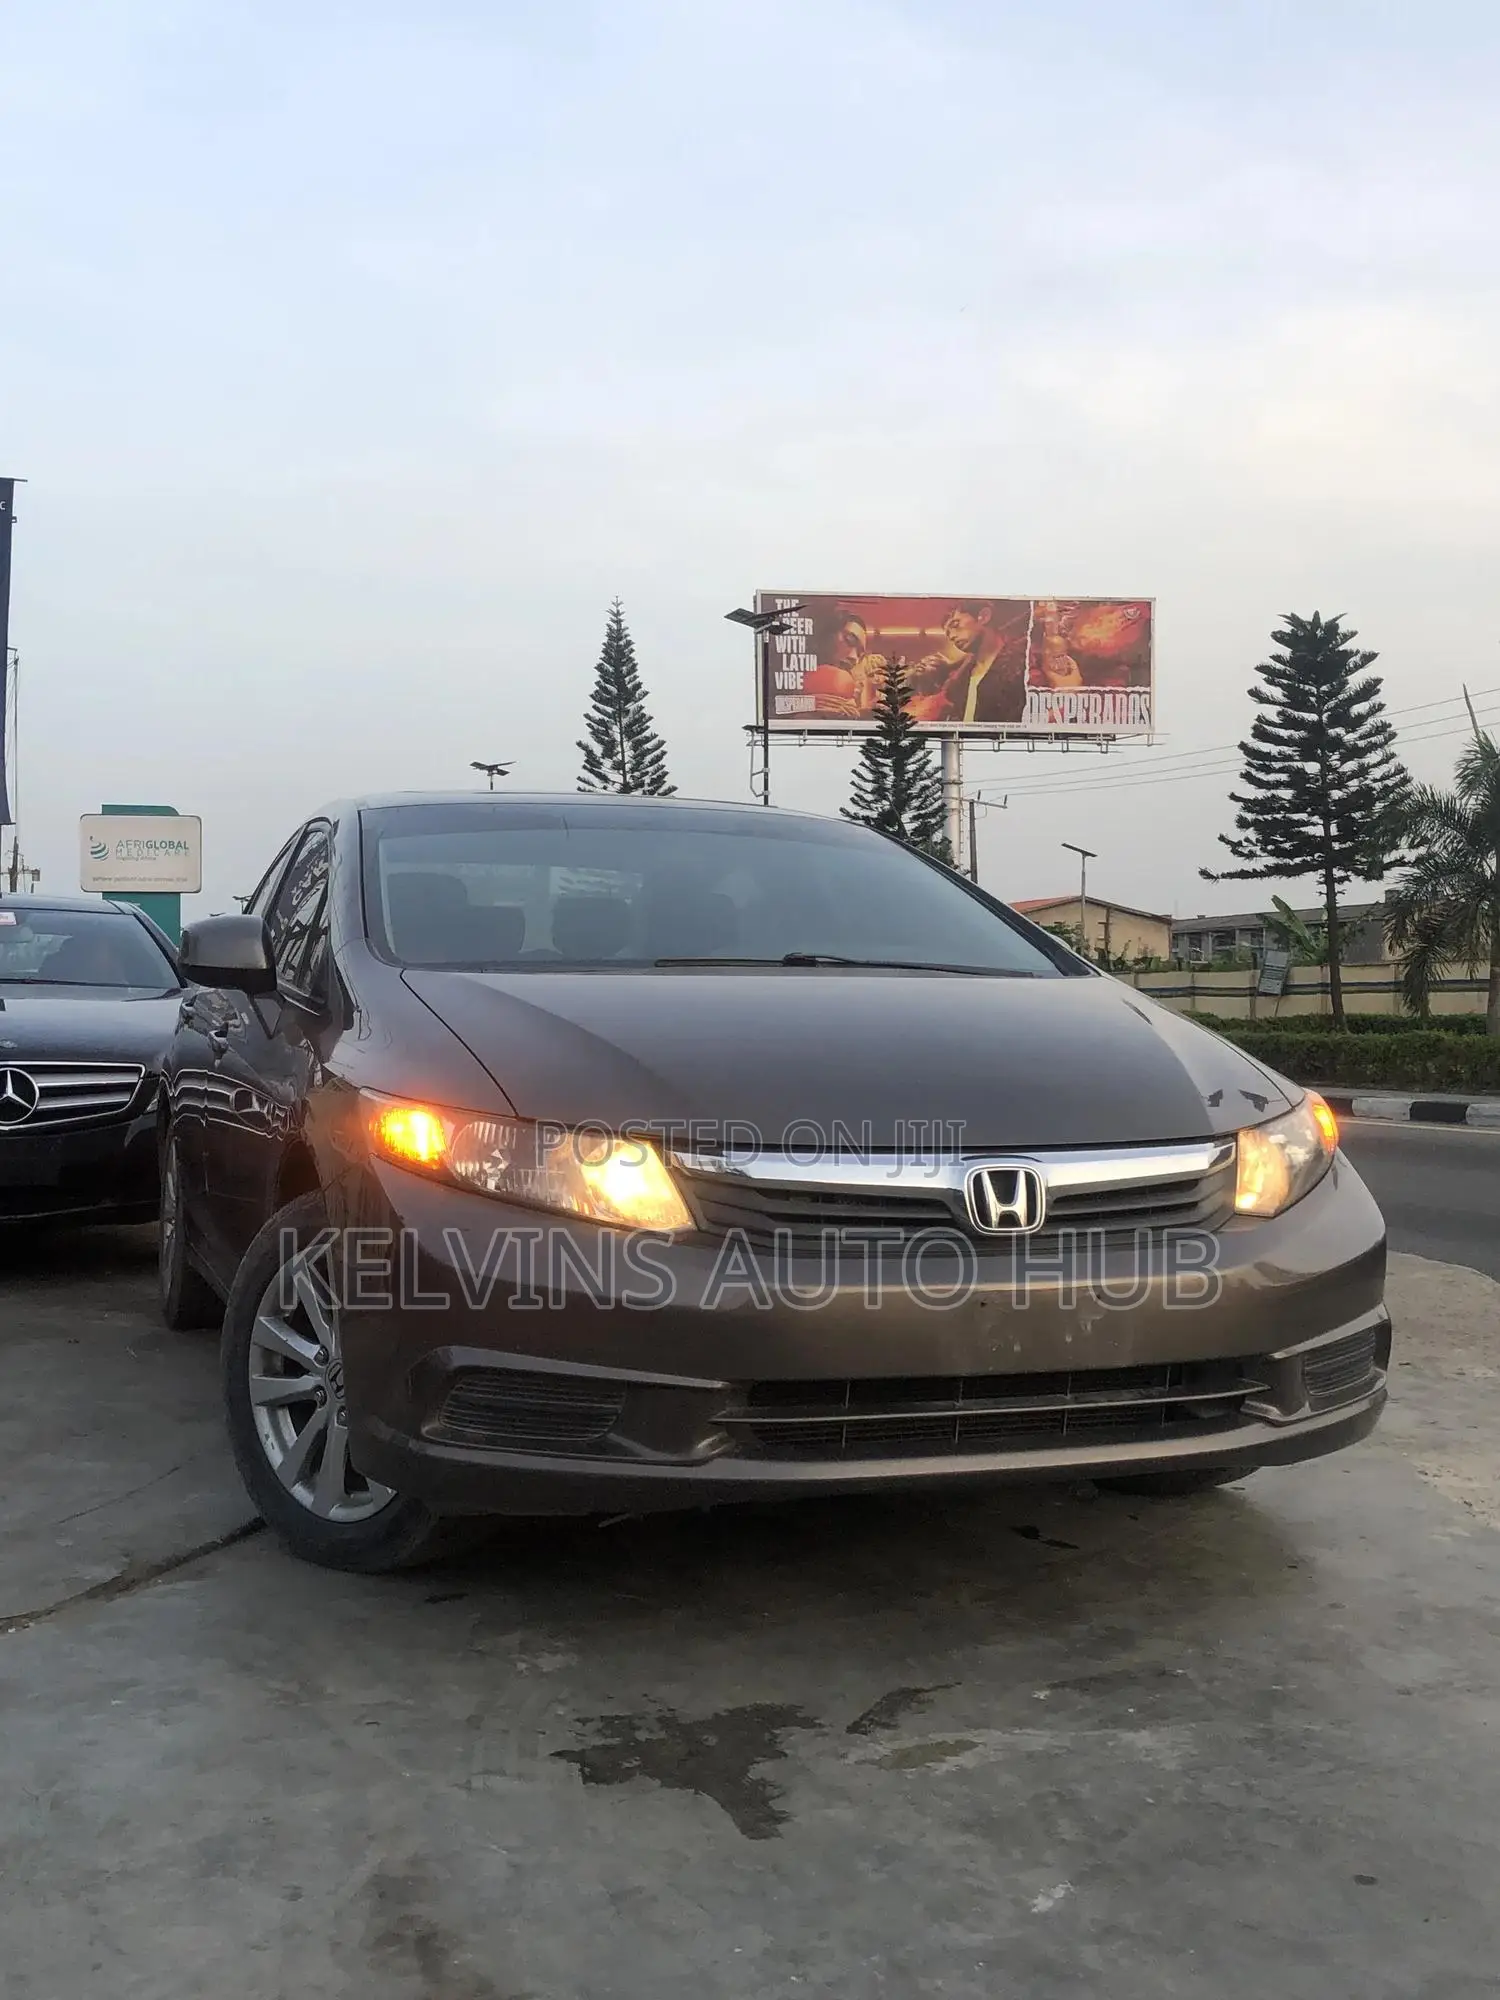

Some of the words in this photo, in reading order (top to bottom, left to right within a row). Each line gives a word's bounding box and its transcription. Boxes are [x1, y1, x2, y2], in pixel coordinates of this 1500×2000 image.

[775, 635, 806, 653] WITH
[782, 653, 818, 672] LATIN
[774, 671, 804, 690] VIBE
[116, 839, 190, 850] AFRIGLOBAL
